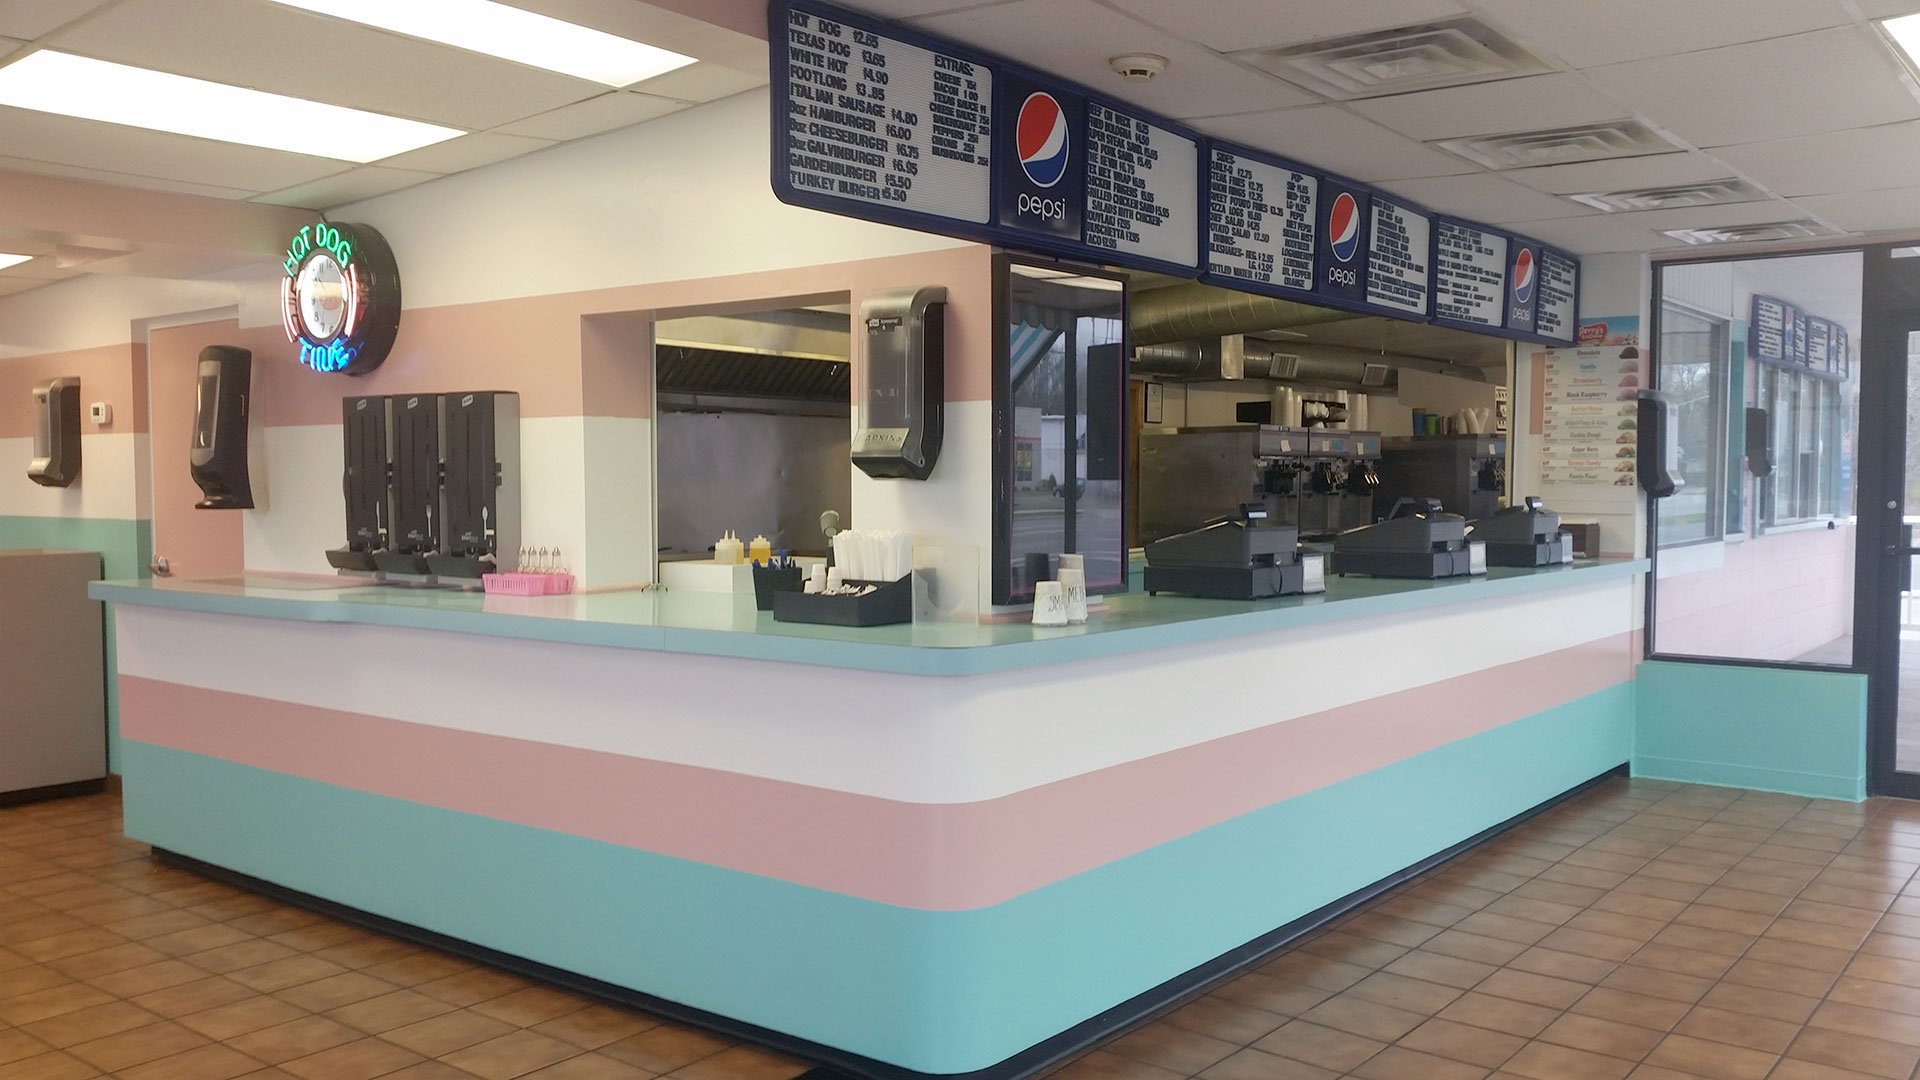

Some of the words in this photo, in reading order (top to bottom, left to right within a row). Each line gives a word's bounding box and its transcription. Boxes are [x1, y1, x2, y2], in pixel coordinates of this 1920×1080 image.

[788, 11, 809, 28] HOT
[819, 19, 841, 37] DOG
[790, 29, 825, 50] TEXAS
[829, 38, 850, 58] DOG
[862, 50, 886, 68] $3.65
[790, 46, 824, 68] WHITE
[827, 55, 848, 74] HOT
[863, 67, 888, 85] $4.90
[790, 65, 847, 92] FOOTLONG
[790, 82, 834, 105] ITALIAN
[838, 95, 885, 118] SAUSAGE
[934, 81, 958, 96] BACON
[810, 104, 876, 132] HAMBURGER
[885, 124, 912, 140] $6.00
[809, 124, 888, 152] CHEESEBURGER
[896, 143, 919, 160] $6.75
[790, 153, 876, 183] GARDENBURGER
[884, 173, 911, 190] $5.50
[790, 170, 834, 191] TURKEY
[839, 181, 880, 200] BURGER
[1018, 194, 1066, 221] pepsi
[1211, 203, 1226, 214] IZZA
[1088, 234, 1101, 246] ACO
[1211, 222, 1229, 235] OTATO
[282, 226, 310, 277] HOT
[316, 223, 352, 269] DOG
[1210, 263, 1232, 276] OTTLED
[1329, 267, 1356, 286] pepsi
[1513, 307, 1531, 322] pepsi
